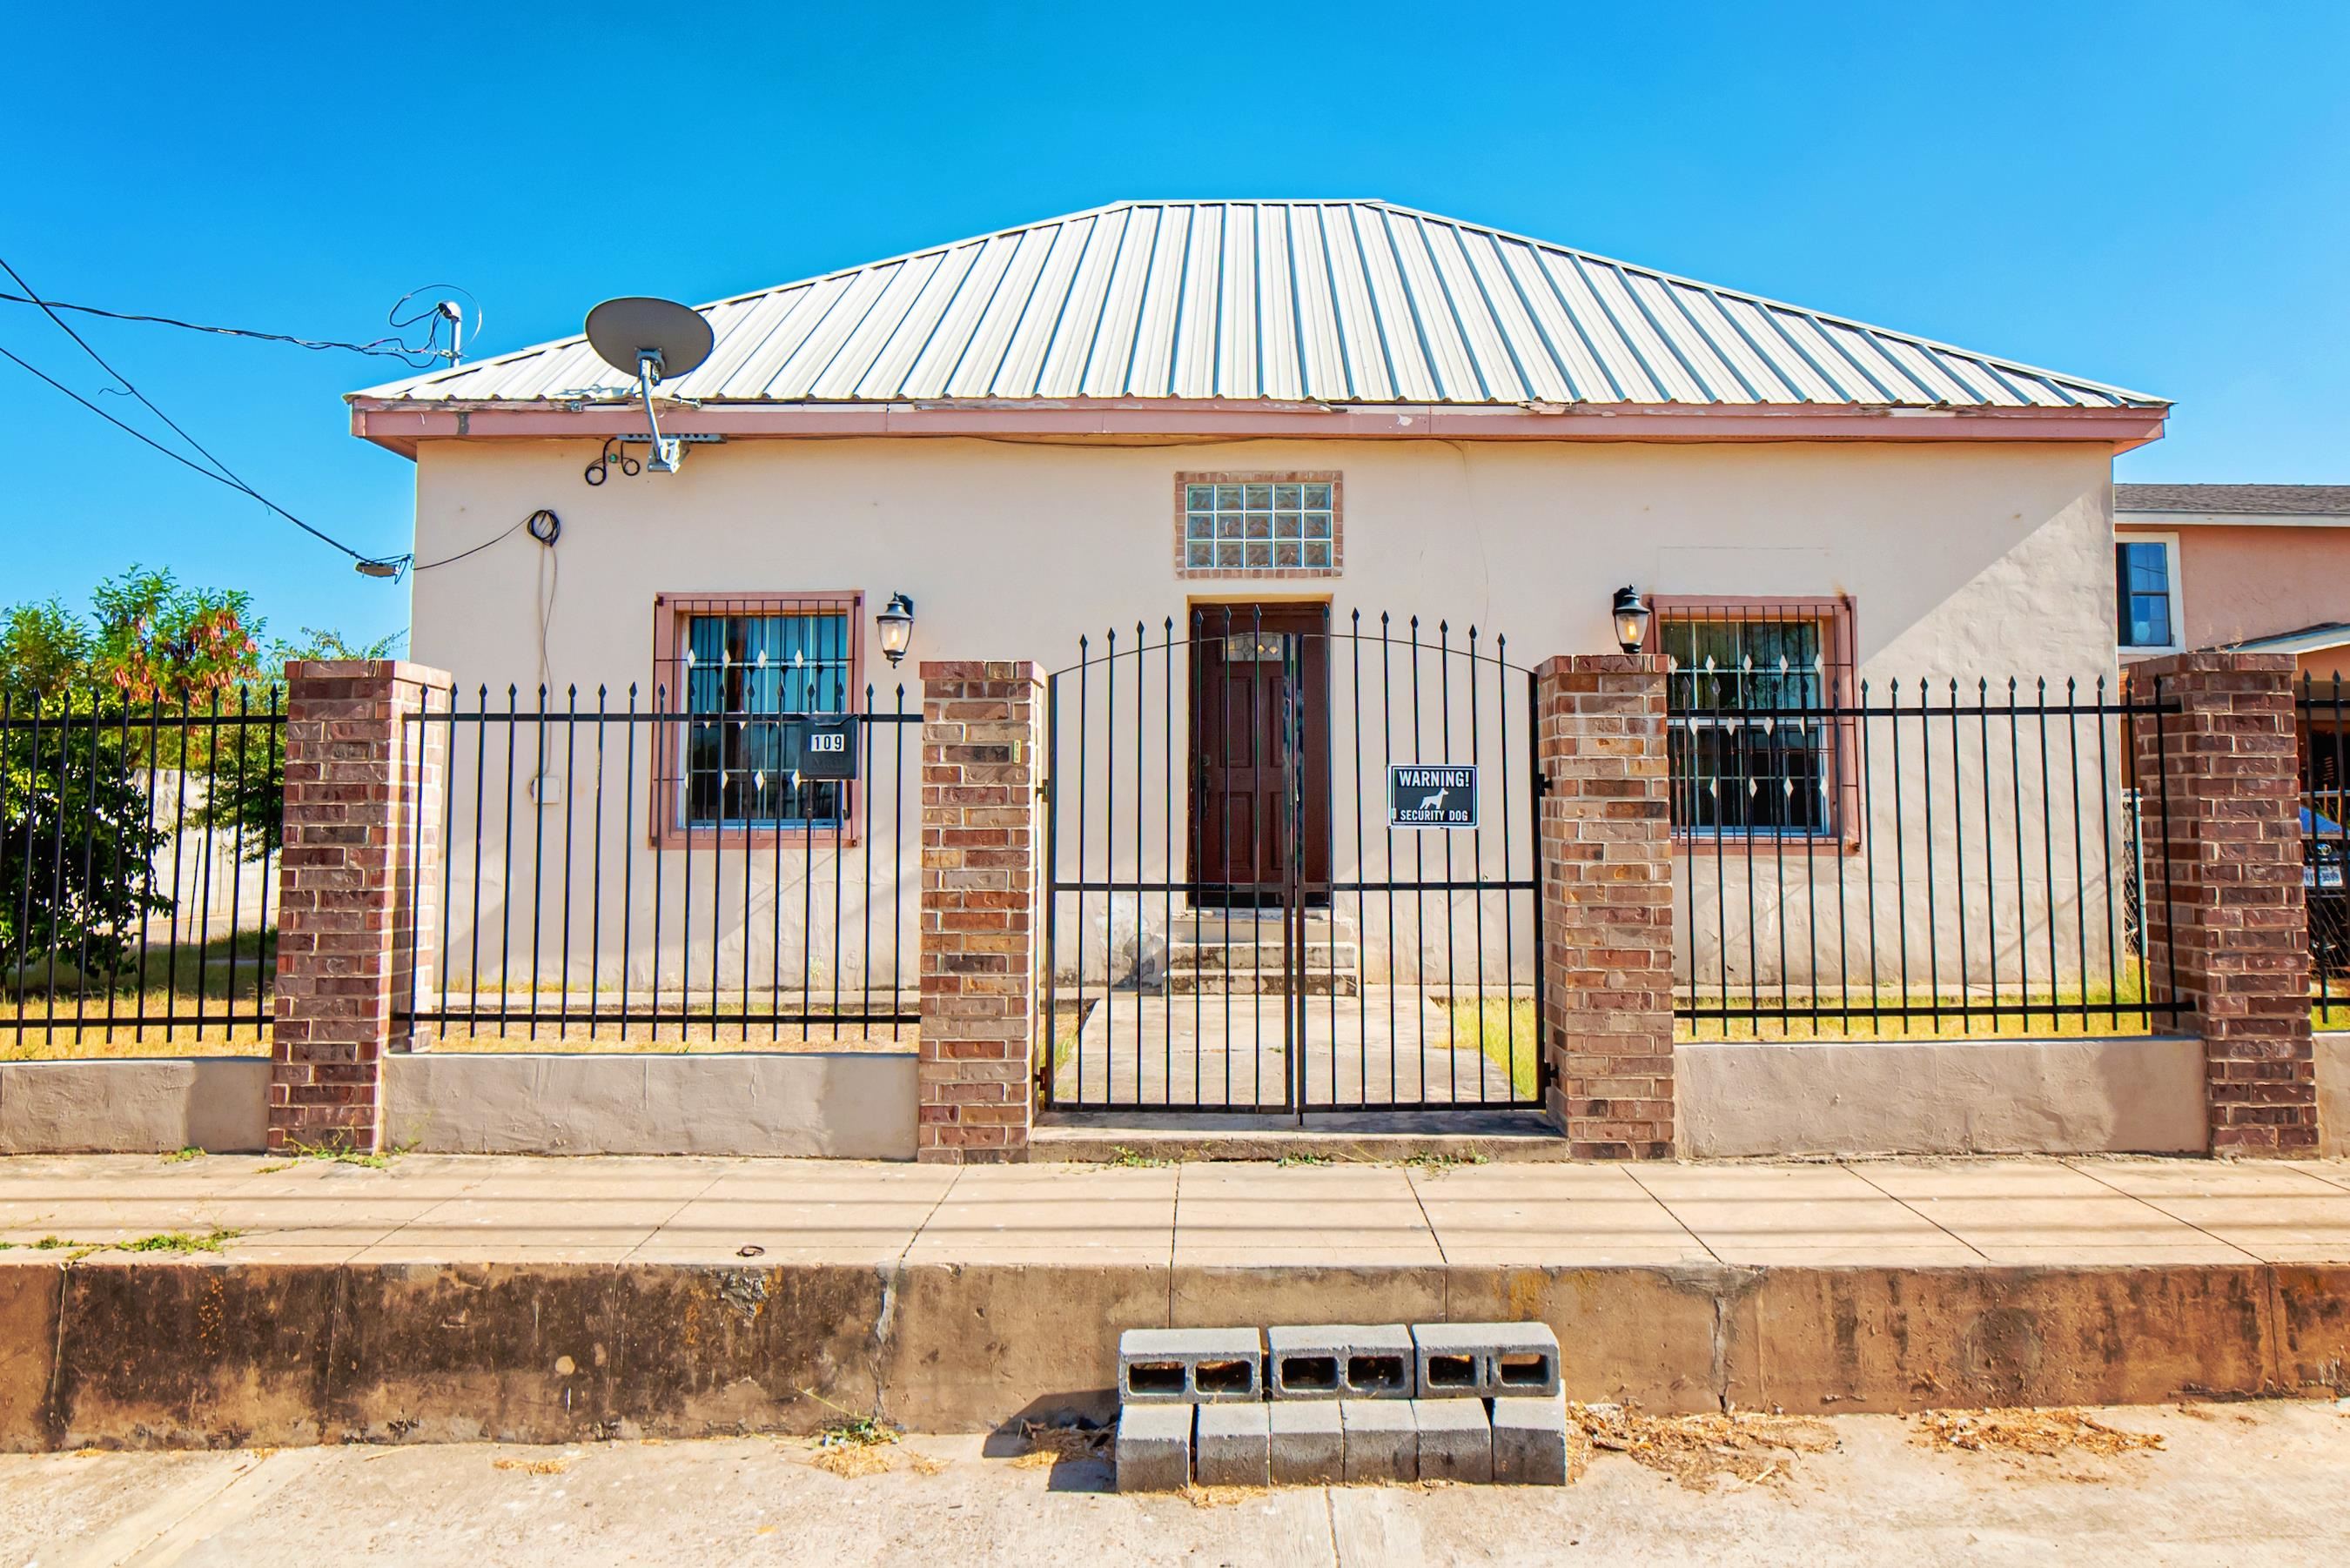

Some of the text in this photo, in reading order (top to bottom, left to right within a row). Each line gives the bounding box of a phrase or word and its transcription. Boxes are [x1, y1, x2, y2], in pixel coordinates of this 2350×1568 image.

[814, 735, 843, 750] 109
[1399, 771, 1470, 787] WARNING!
[1400, 809, 1468, 821] SECURITY DOG
